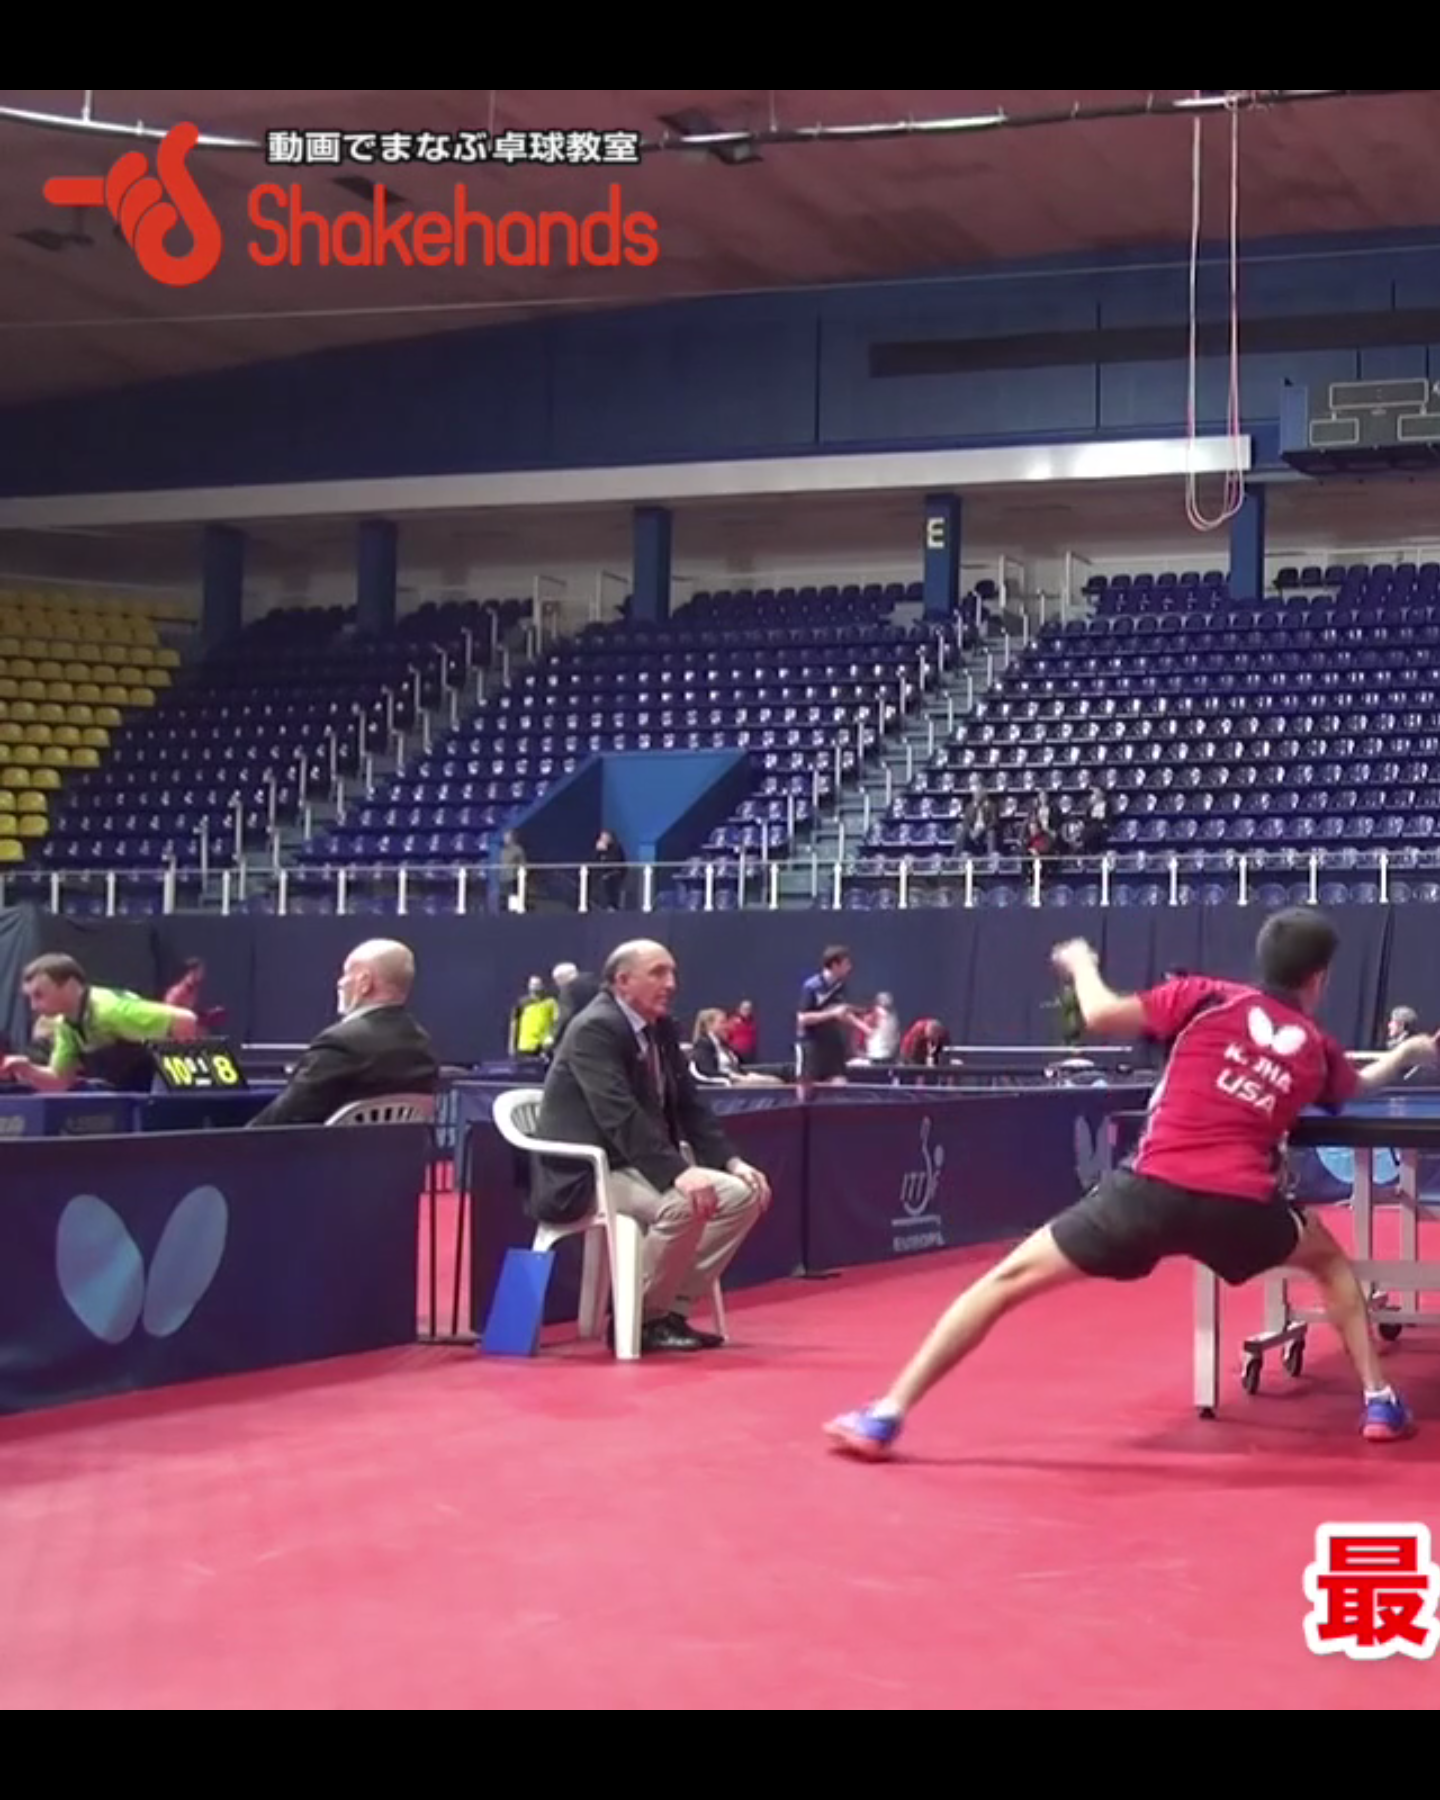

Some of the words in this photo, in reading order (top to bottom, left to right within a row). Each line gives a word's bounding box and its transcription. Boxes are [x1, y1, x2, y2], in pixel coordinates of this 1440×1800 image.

[927, 517, 945, 549] E
[212, 1055, 238, 1085] 8
[1216, 1067, 1276, 1116] USA
